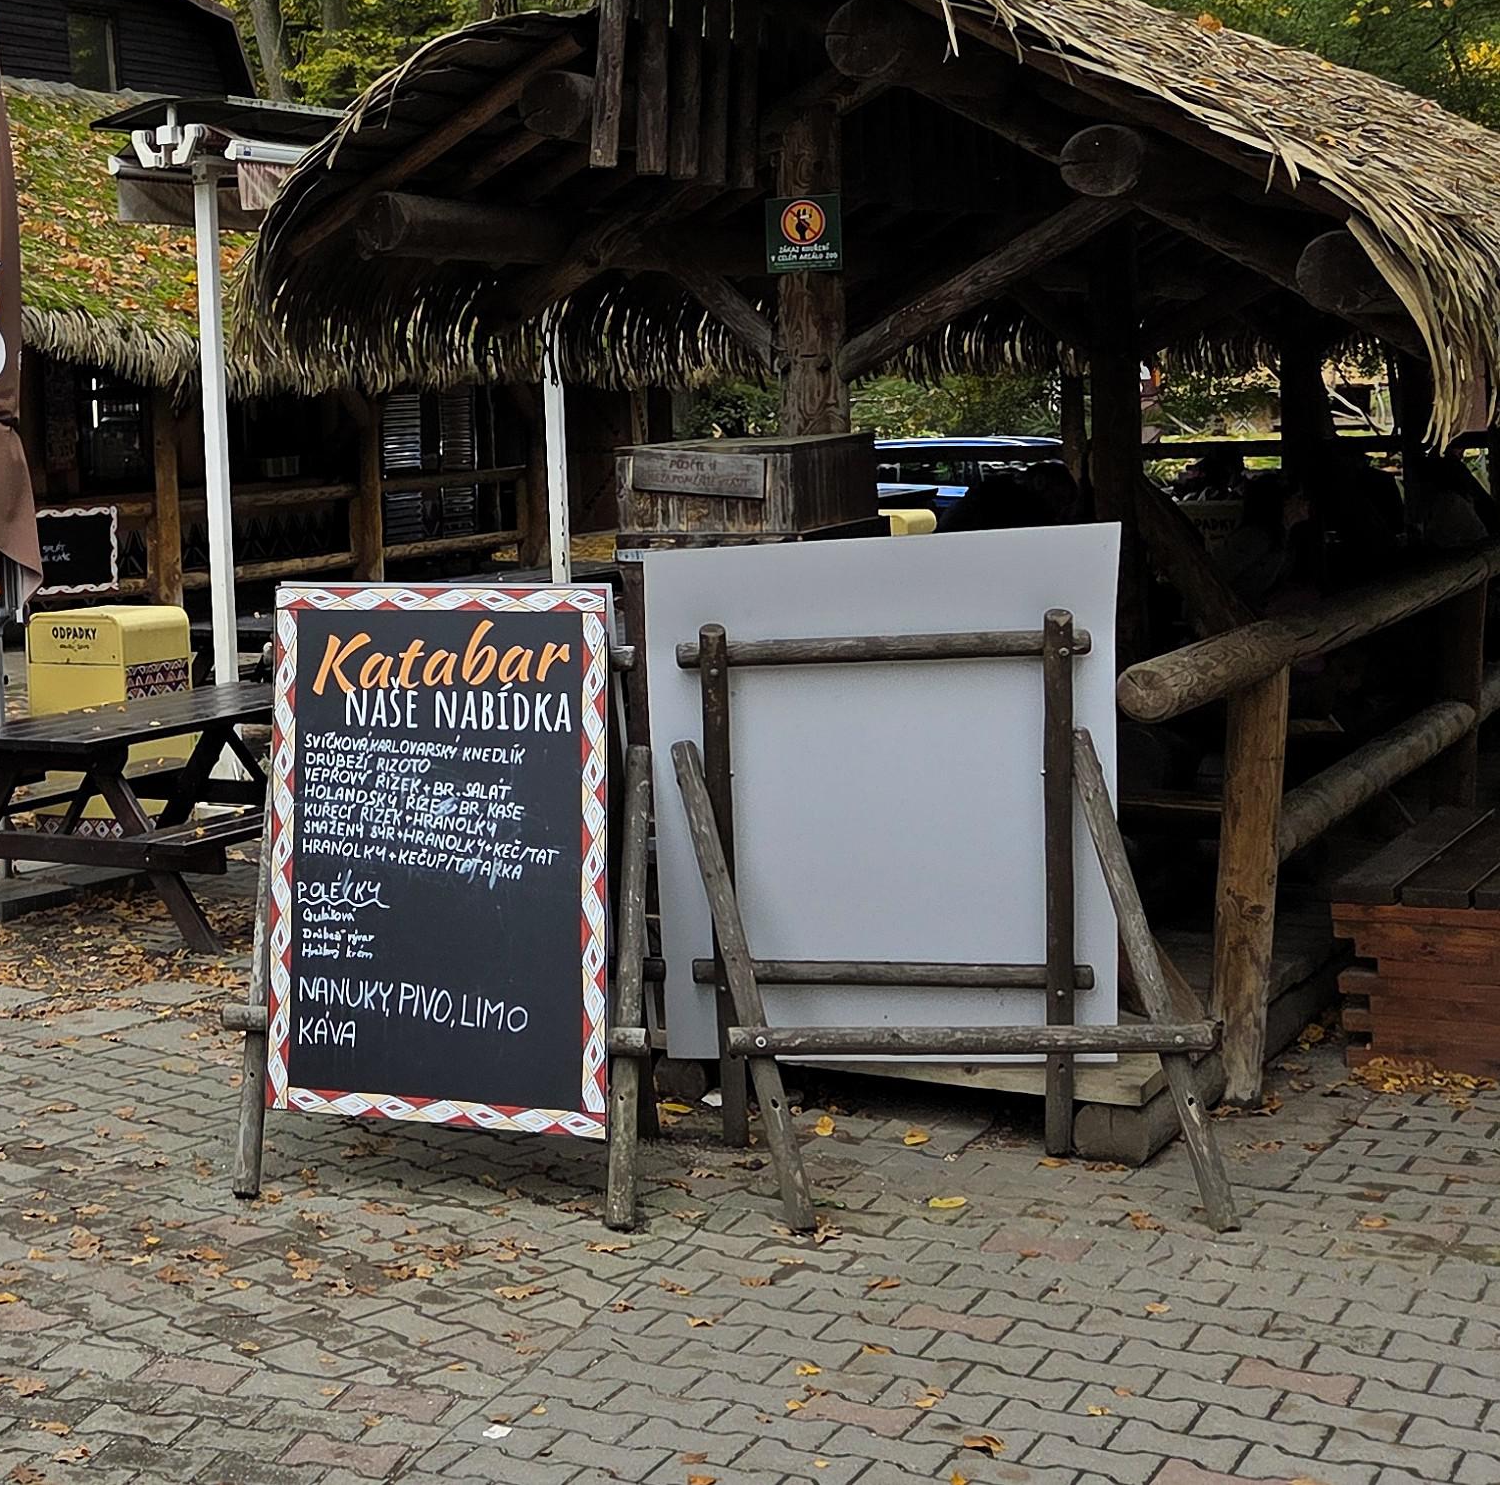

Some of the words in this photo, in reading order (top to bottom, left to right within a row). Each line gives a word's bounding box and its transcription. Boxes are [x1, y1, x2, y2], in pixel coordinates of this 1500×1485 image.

[51, 626, 97, 641] ODPADKY
[312, 618, 572, 697] Katabar
[345, 676, 419, 730] NAŠE
[434, 682, 573, 733] NABÍDKA
[305, 750, 373, 771] DRŮBEŽÍ
[376, 757, 431, 774] RIZOTO
[462, 743, 527, 766] KNEDLÍK
[304, 766, 373, 787] VEPŘOVÝ
[303, 802, 357, 822] KUŘECÍ
[304, 782, 398, 810] HOLANDSKÝ
[486, 802, 526, 822] KAŠE
[296, 869, 382, 902] POLÉVKY
[298, 1011, 357, 1048] KÁVA
[460, 994, 529, 1033] LIMO
